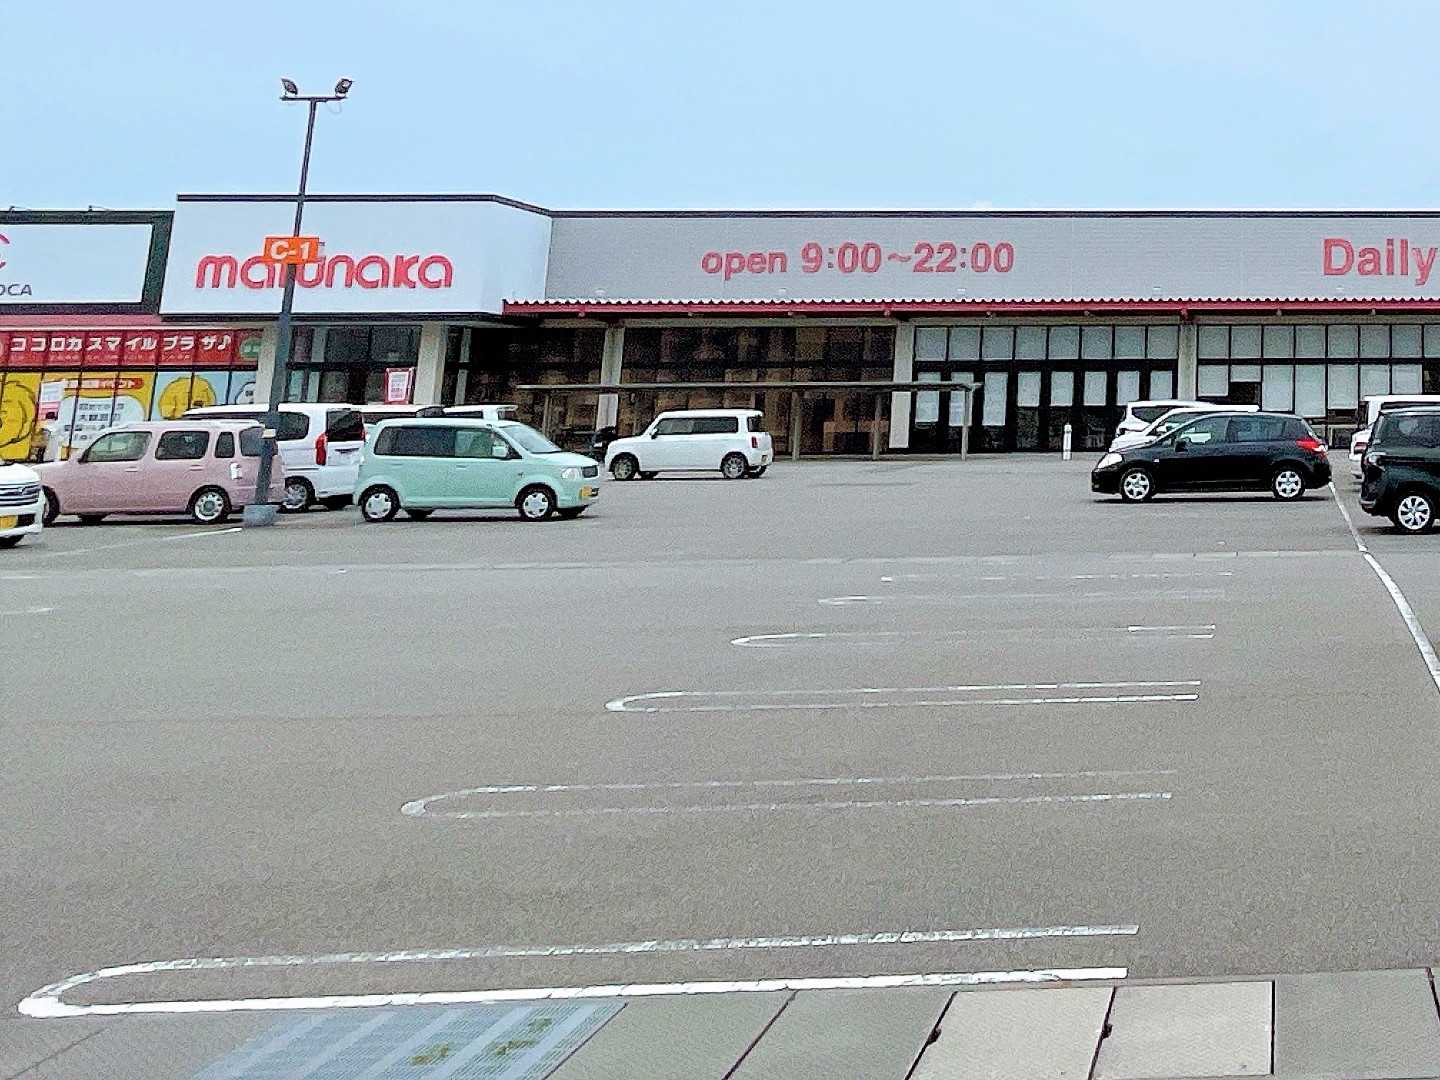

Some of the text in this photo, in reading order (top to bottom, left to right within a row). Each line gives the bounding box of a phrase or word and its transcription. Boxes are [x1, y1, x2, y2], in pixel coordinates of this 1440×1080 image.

[270, 240, 311, 260] C-1
[1323, 238, 1437, 286] Daily
[701, 252, 787, 281] open
